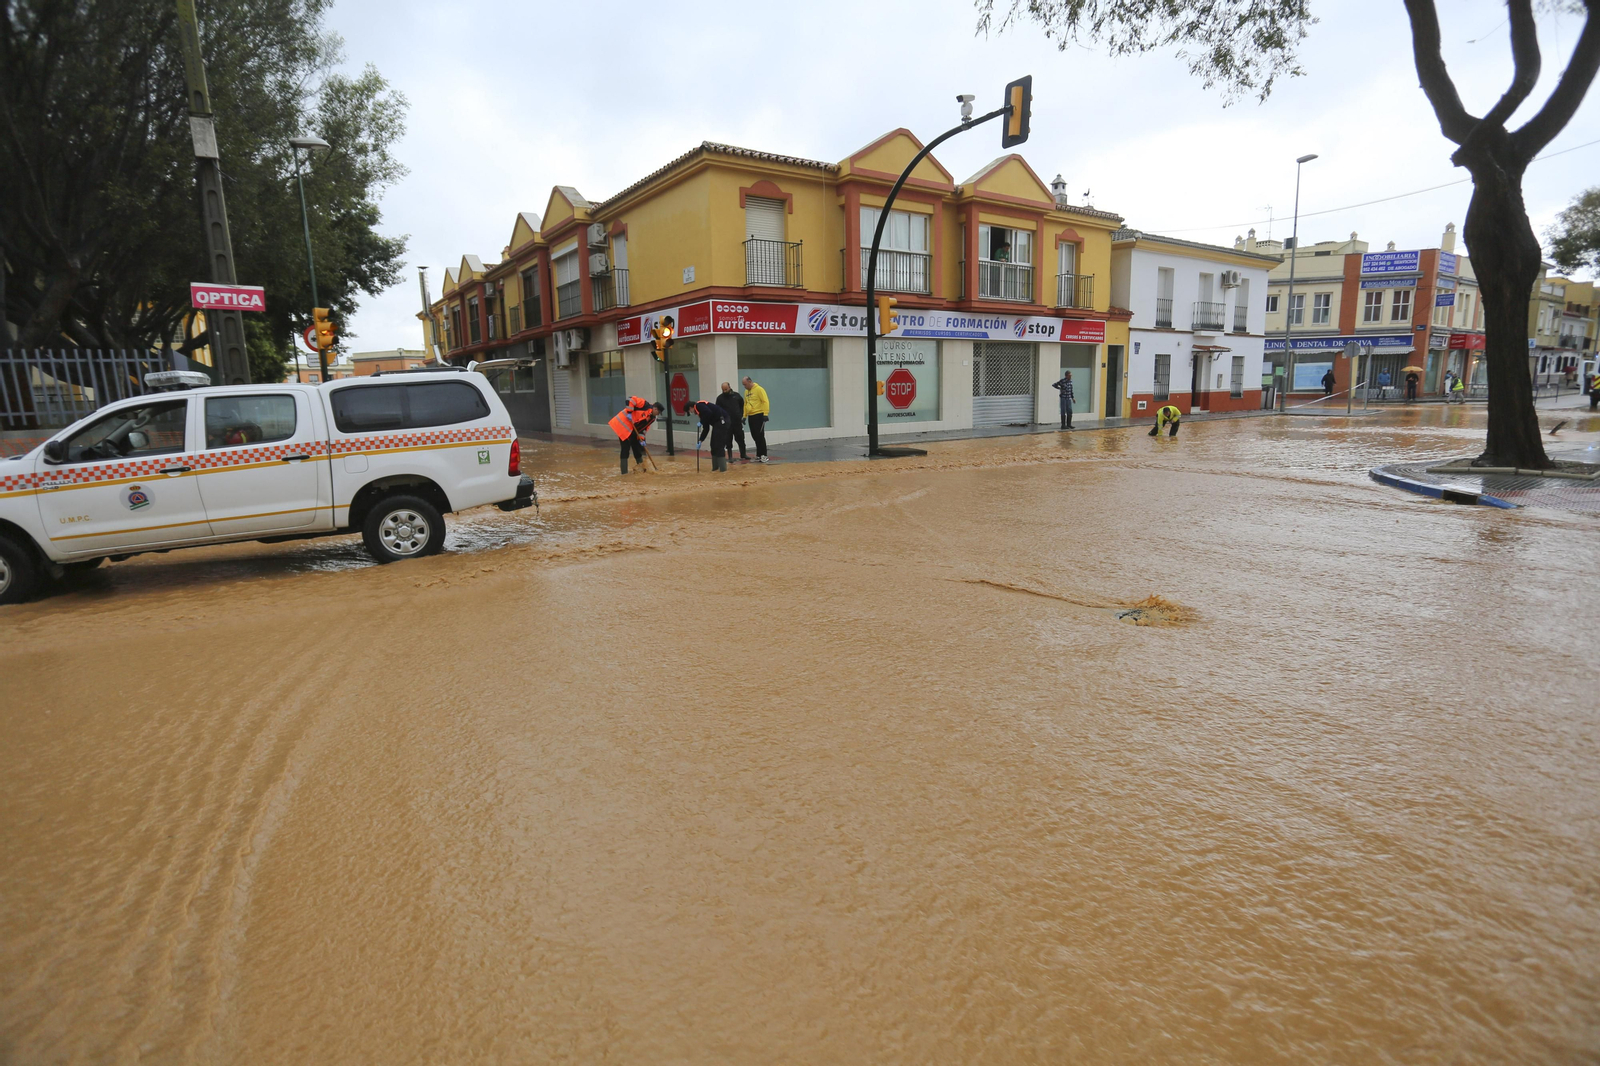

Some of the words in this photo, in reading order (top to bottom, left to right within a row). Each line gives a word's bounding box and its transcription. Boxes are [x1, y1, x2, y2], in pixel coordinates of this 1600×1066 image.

[195, 291, 263, 306] OPTICA
[684, 322, 708, 333] FORMACIÓN
[717, 321, 786, 330] AUTOESCUELA
[830, 313, 868, 331] stop
[878, 315, 924, 327] NTRO
[929, 316, 942, 327] DE
[946, 317, 1007, 329] FORMACIÓN
[1028, 322, 1055, 337] stop
[883, 341, 912, 350] CURSO
[1297, 340, 1328, 348] DENTAL
[673, 388, 686, 402] STOP
[59, 514, 92, 524] U.M.P.C.
